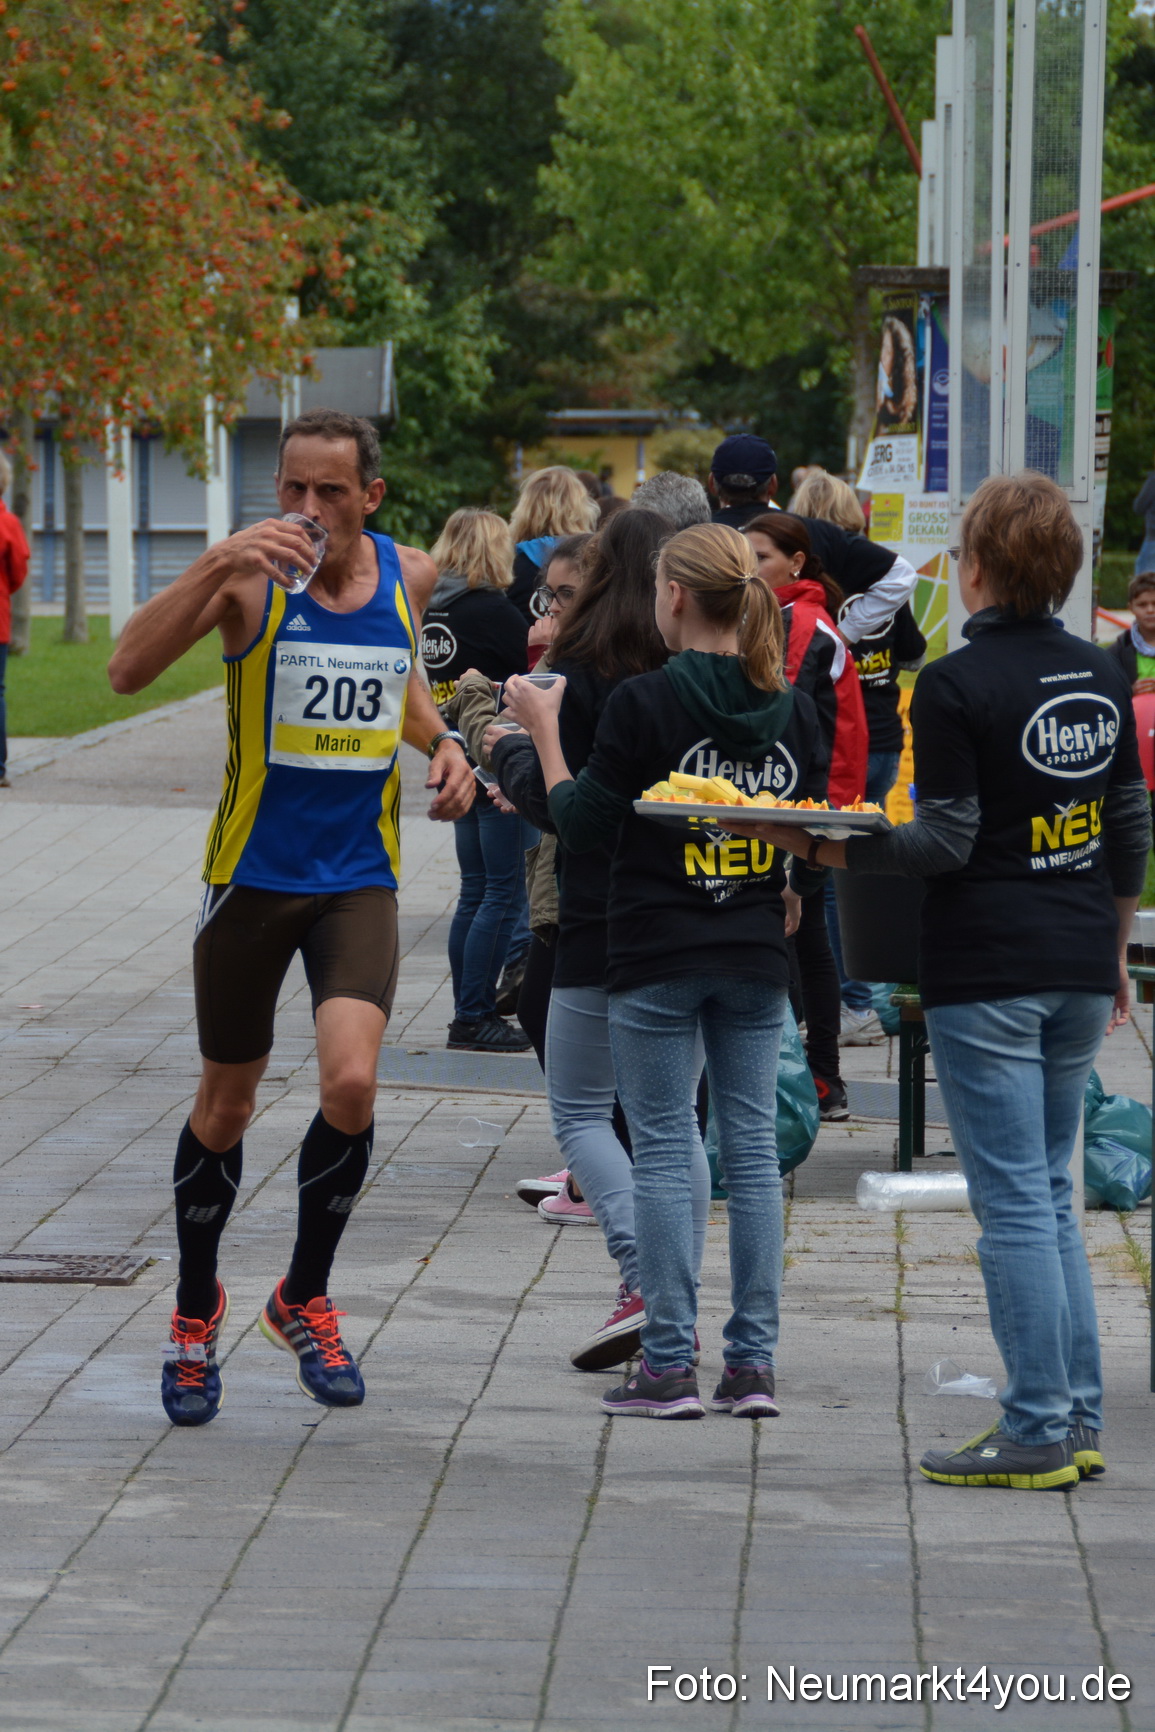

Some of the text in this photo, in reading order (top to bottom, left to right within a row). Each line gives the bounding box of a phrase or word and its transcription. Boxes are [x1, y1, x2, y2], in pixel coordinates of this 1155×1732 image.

[908, 512, 949, 524] GROSS
[280, 655, 389, 671] PARTL Neumarkt
[1040, 671, 1093, 683] www.hervis.com
[302, 675, 383, 722] 203
[277, 714, 284, 722] A
[1037, 713, 1116, 756] Hervis
[315, 734, 361, 752] Mario
[1046, 751, 1089, 765] SPORTS
[1031, 796, 1104, 852] NEU
[684, 838, 775, 876] NEU
[1030, 857, 1047, 869] IN
